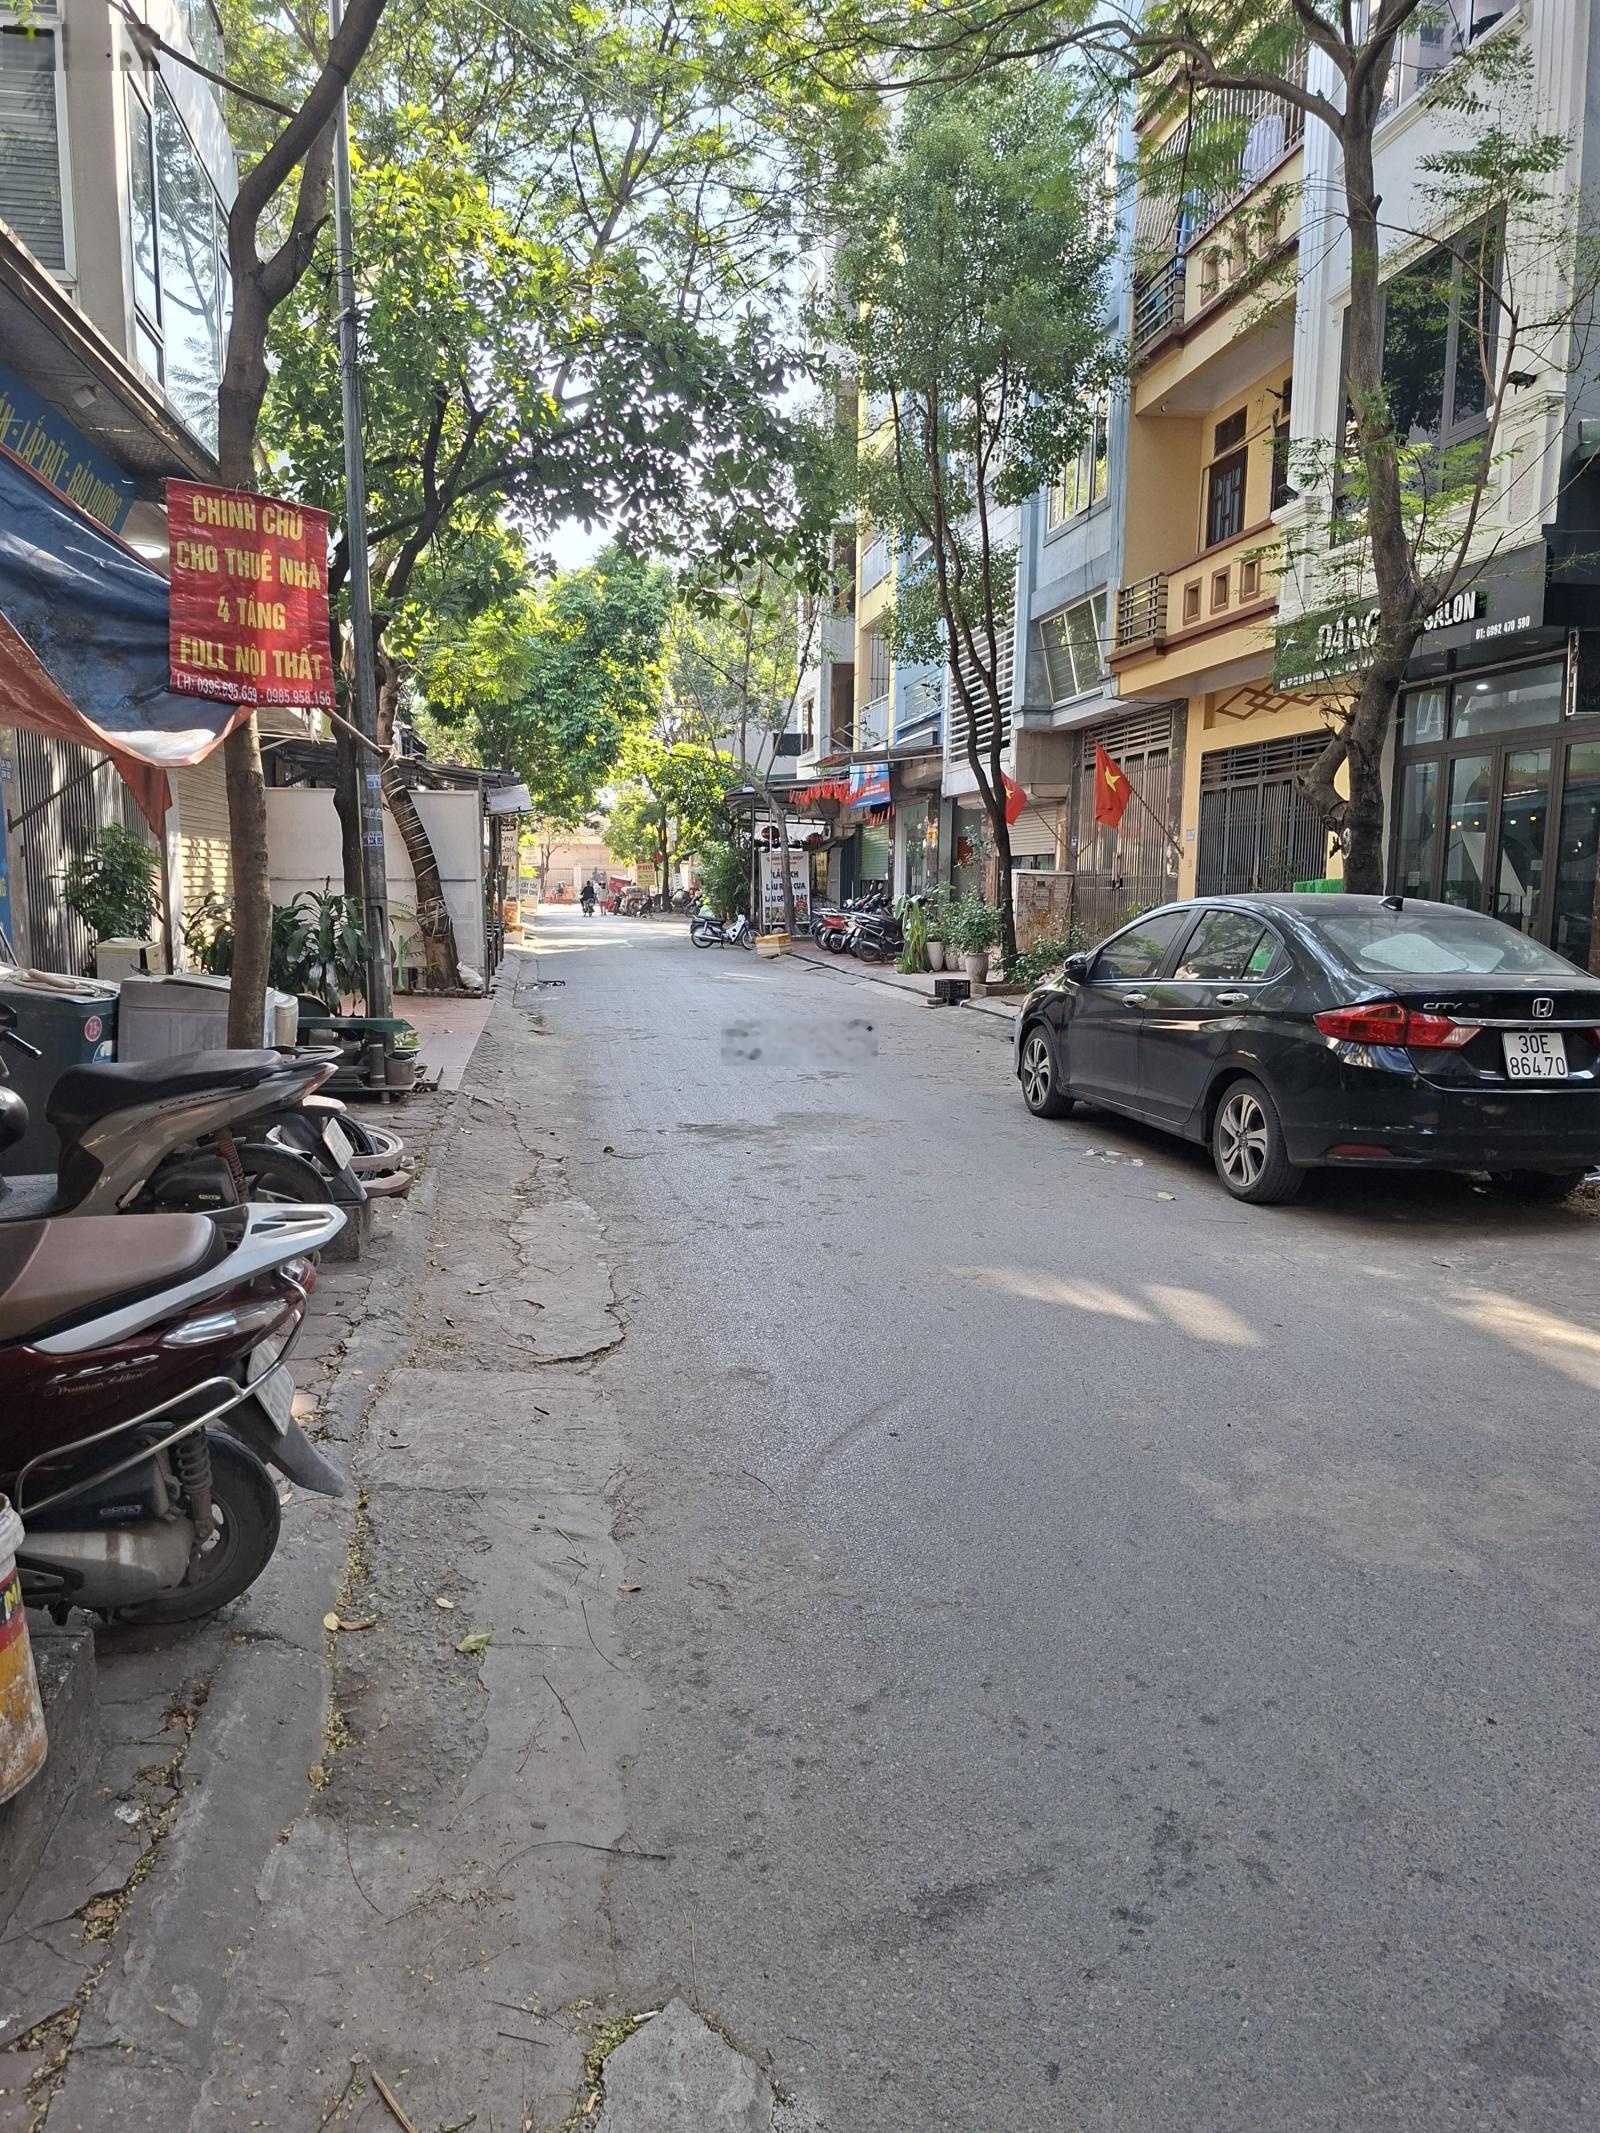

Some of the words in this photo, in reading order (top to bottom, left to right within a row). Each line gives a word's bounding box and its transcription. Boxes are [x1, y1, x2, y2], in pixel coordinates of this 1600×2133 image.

[192, 494, 257, 532] CHÍNH
[262, 505, 303, 541] CHỦ
[176, 541, 218, 573] CHO
[225, 548, 273, 583] THUÊ
[279, 557, 321, 590] NHÀ
[217, 595, 231, 623] 4
[236, 592, 286, 630] TẦNG
[1423, 591, 1476, 631] SALON
[180, 637, 229, 671] FULL
[235, 643, 267, 682] NỘI
[272, 644, 322, 680] THẤT
[177, 673, 194, 690] LH:
[266, 688, 331, 706] 0985.958.156
[1423, 1002, 1463, 1010] CITY
[1518, 1034, 1551, 1054] 30E
[1509, 1056, 1566, 1076] 864.70
[46, 1354, 160, 1385] LEAD
